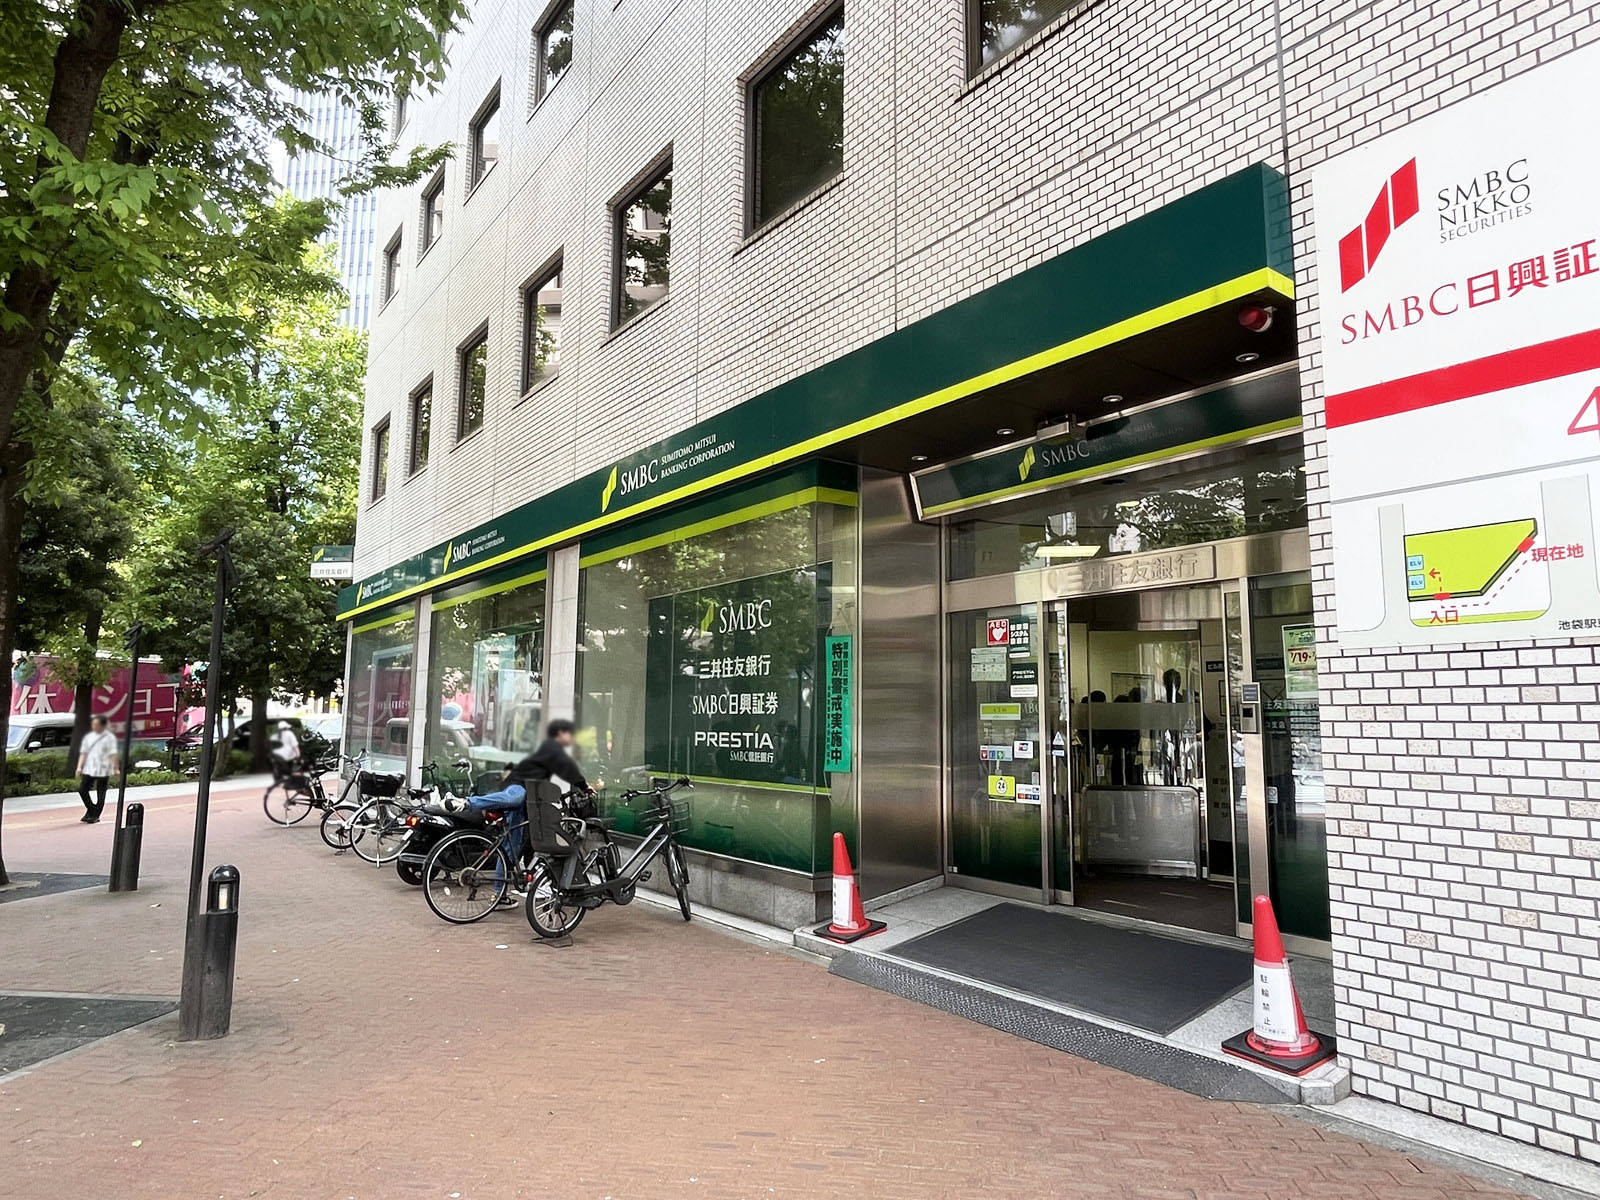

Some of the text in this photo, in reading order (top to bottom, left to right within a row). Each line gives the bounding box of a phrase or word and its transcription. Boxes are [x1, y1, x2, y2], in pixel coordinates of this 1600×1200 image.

[1437, 158, 1529, 212] SMBC
[1439, 183, 1531, 232] NIKKO
[1439, 202, 1533, 244] SECURITIES
[1341, 238, 1600, 345] SMBC日興証
[620, 433, 717, 496] SMBC SUMITOMO MITSUI
[660, 440, 735, 479] BANKING CORPORATION
[1041, 439, 1090, 468] SMBC
[452, 540, 472, 564] SMBC
[1531, 543, 1584, 563] 現在地
[1060, 551, 1198, 594] 三井住友銀行
[719, 599, 772, 634] SMBC
[989, 620, 1007, 629] AED
[1429, 609, 1459, 624] 入口
[1558, 618, 1600, 631] 池袋駅
[700, 654, 771, 679] 三井住友銀行
[692, 691, 779, 715] SMBC日興証券
[694, 731, 774, 750] PRESTIA
[729, 750, 774, 763] SMBC信託銀行
[997, 782, 1006, 790] 24
